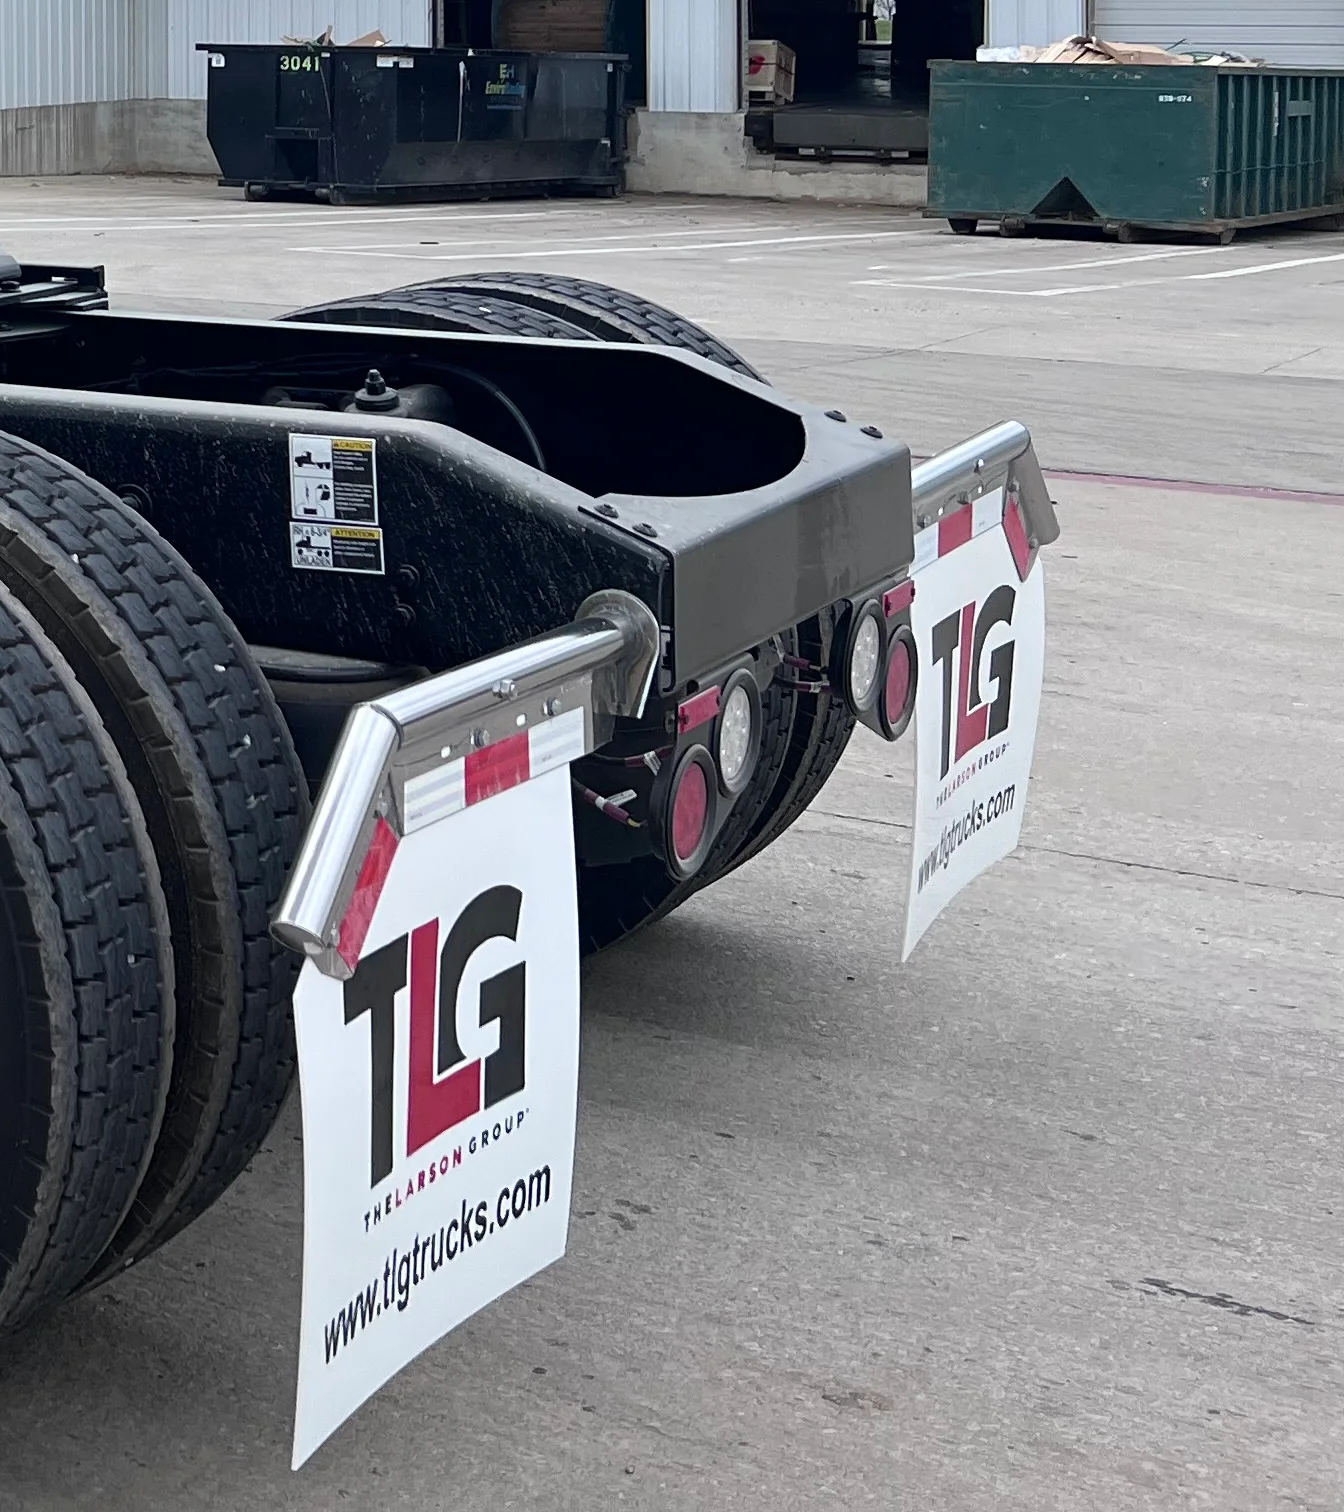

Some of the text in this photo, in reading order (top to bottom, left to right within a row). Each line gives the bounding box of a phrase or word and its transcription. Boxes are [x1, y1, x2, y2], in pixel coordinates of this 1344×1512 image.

[279, 55, 320, 72] 3041
[339, 441, 372, 450] CAUTION
[335, 529, 375, 538] ATTENTION
[931, 585, 1016, 781] TLG
[978, 744, 1006, 770] GROUP
[917, 784, 1016, 894] www.tlgtrucks.com
[343, 885, 527, 1188] TLG
[468, 1110, 525, 1154] GROUP
[324, 1164, 551, 1364] www.tlgtrucks.com
